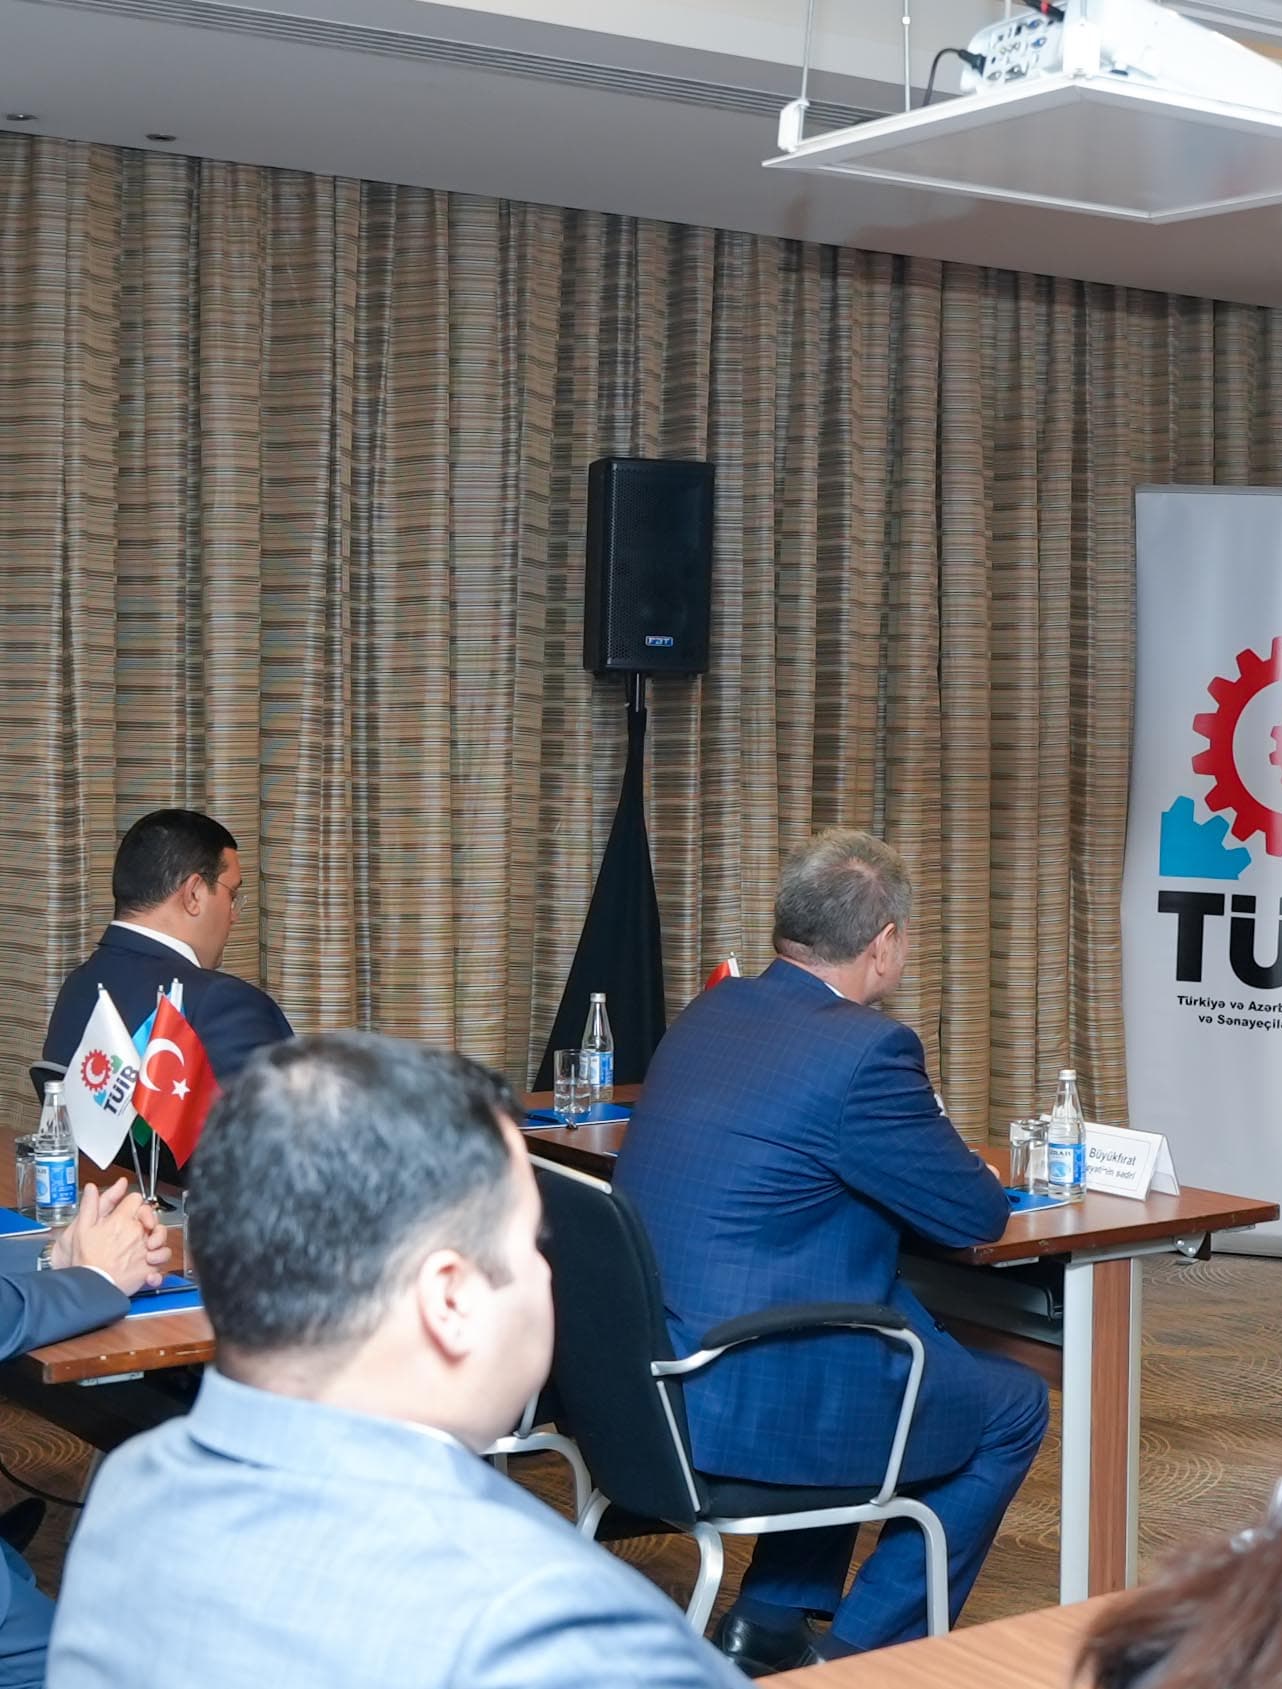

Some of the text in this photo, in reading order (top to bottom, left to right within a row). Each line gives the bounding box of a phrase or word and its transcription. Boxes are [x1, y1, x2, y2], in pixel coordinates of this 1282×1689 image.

[1177, 995, 1225, 1010] Türkiyə
[1230, 1001, 1244, 1010] və
[1198, 1015, 1213, 1025] və
